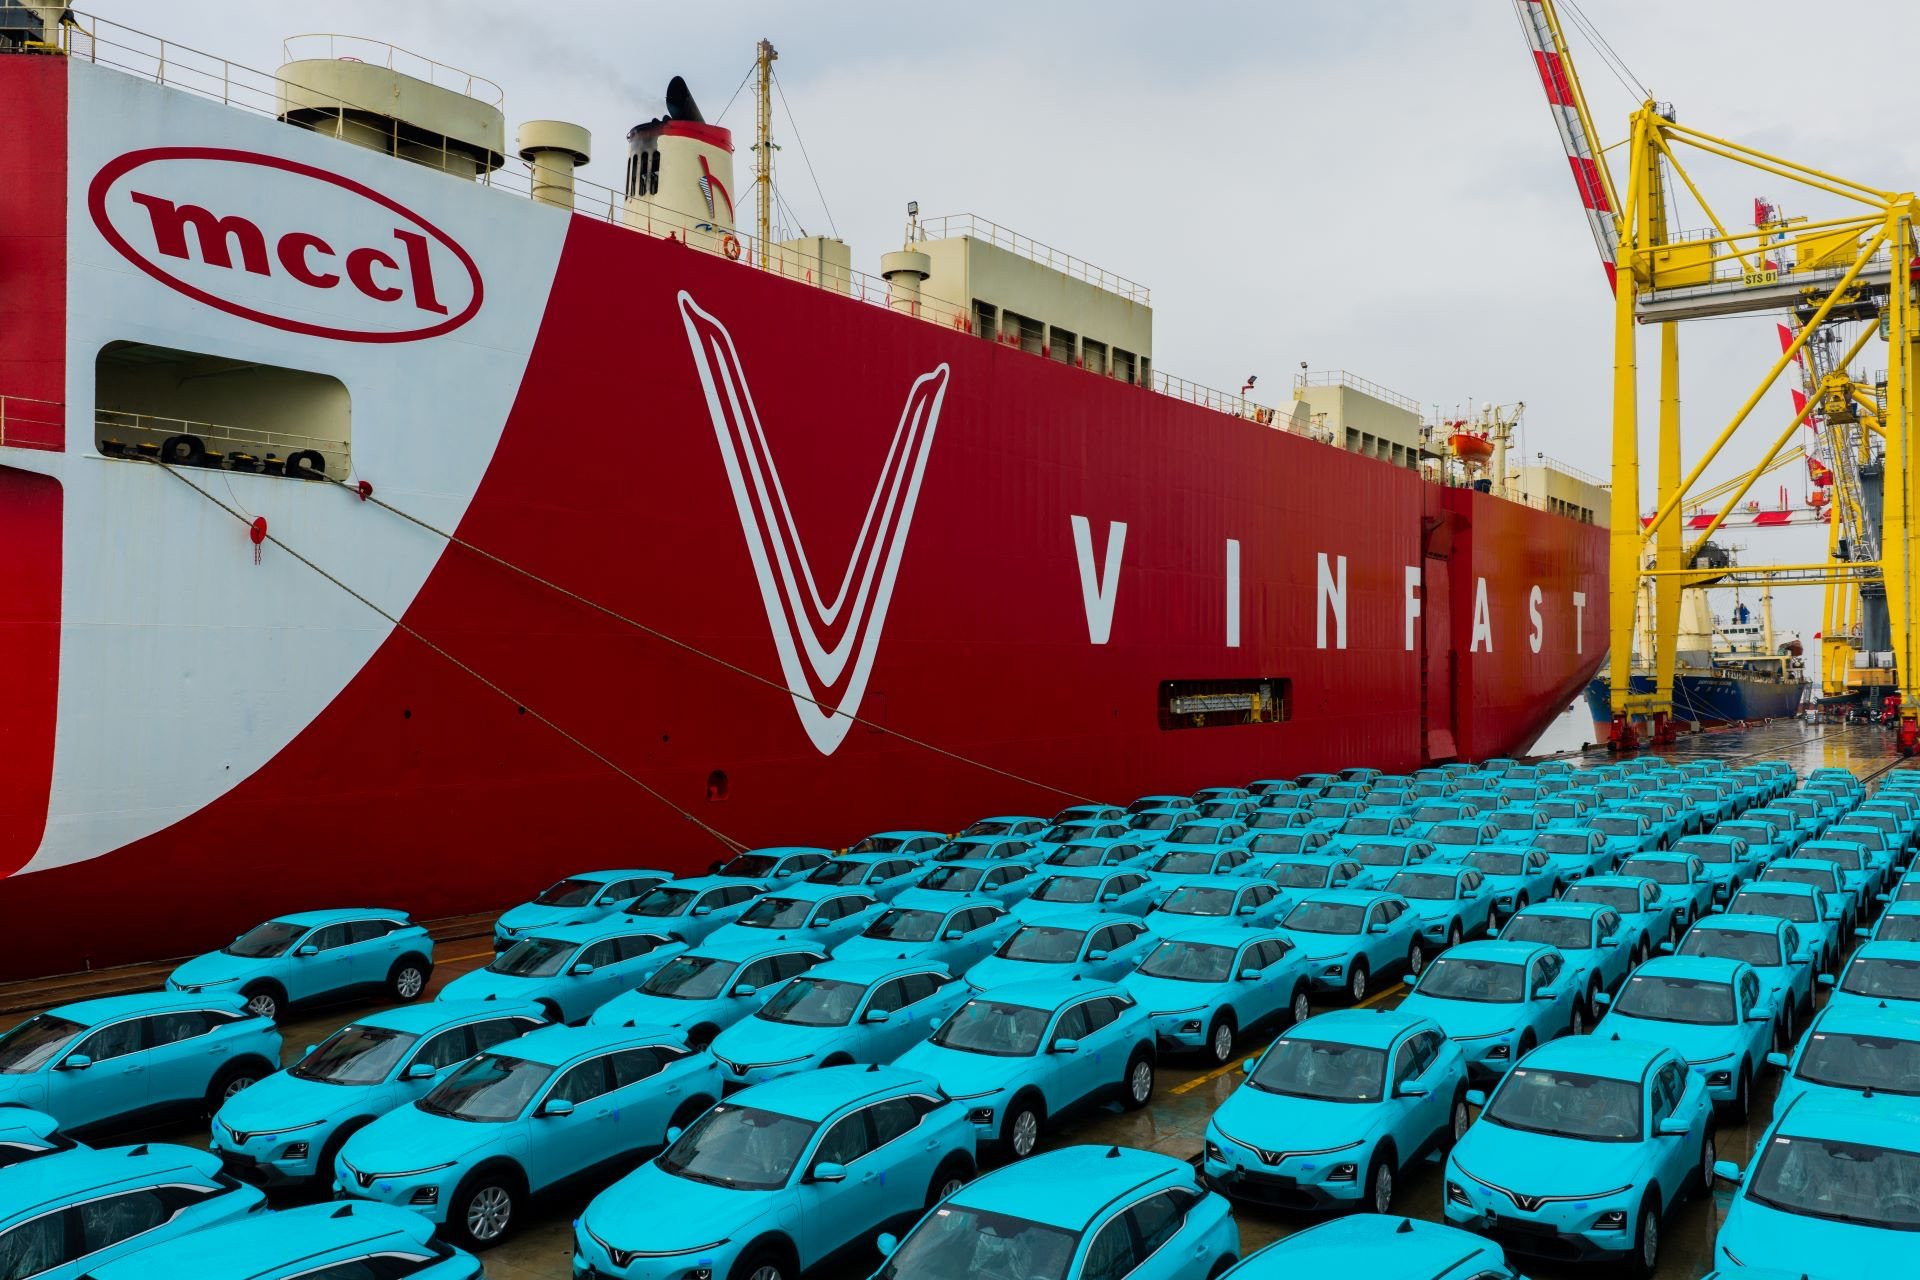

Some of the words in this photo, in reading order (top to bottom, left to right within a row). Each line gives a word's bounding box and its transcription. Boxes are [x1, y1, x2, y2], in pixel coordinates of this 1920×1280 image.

[131, 191, 449, 316] mccl
[1745, 273, 1763, 285] STS
[1765, 272, 1776, 282] 01
[1071, 514, 1586, 655] VINFAST
